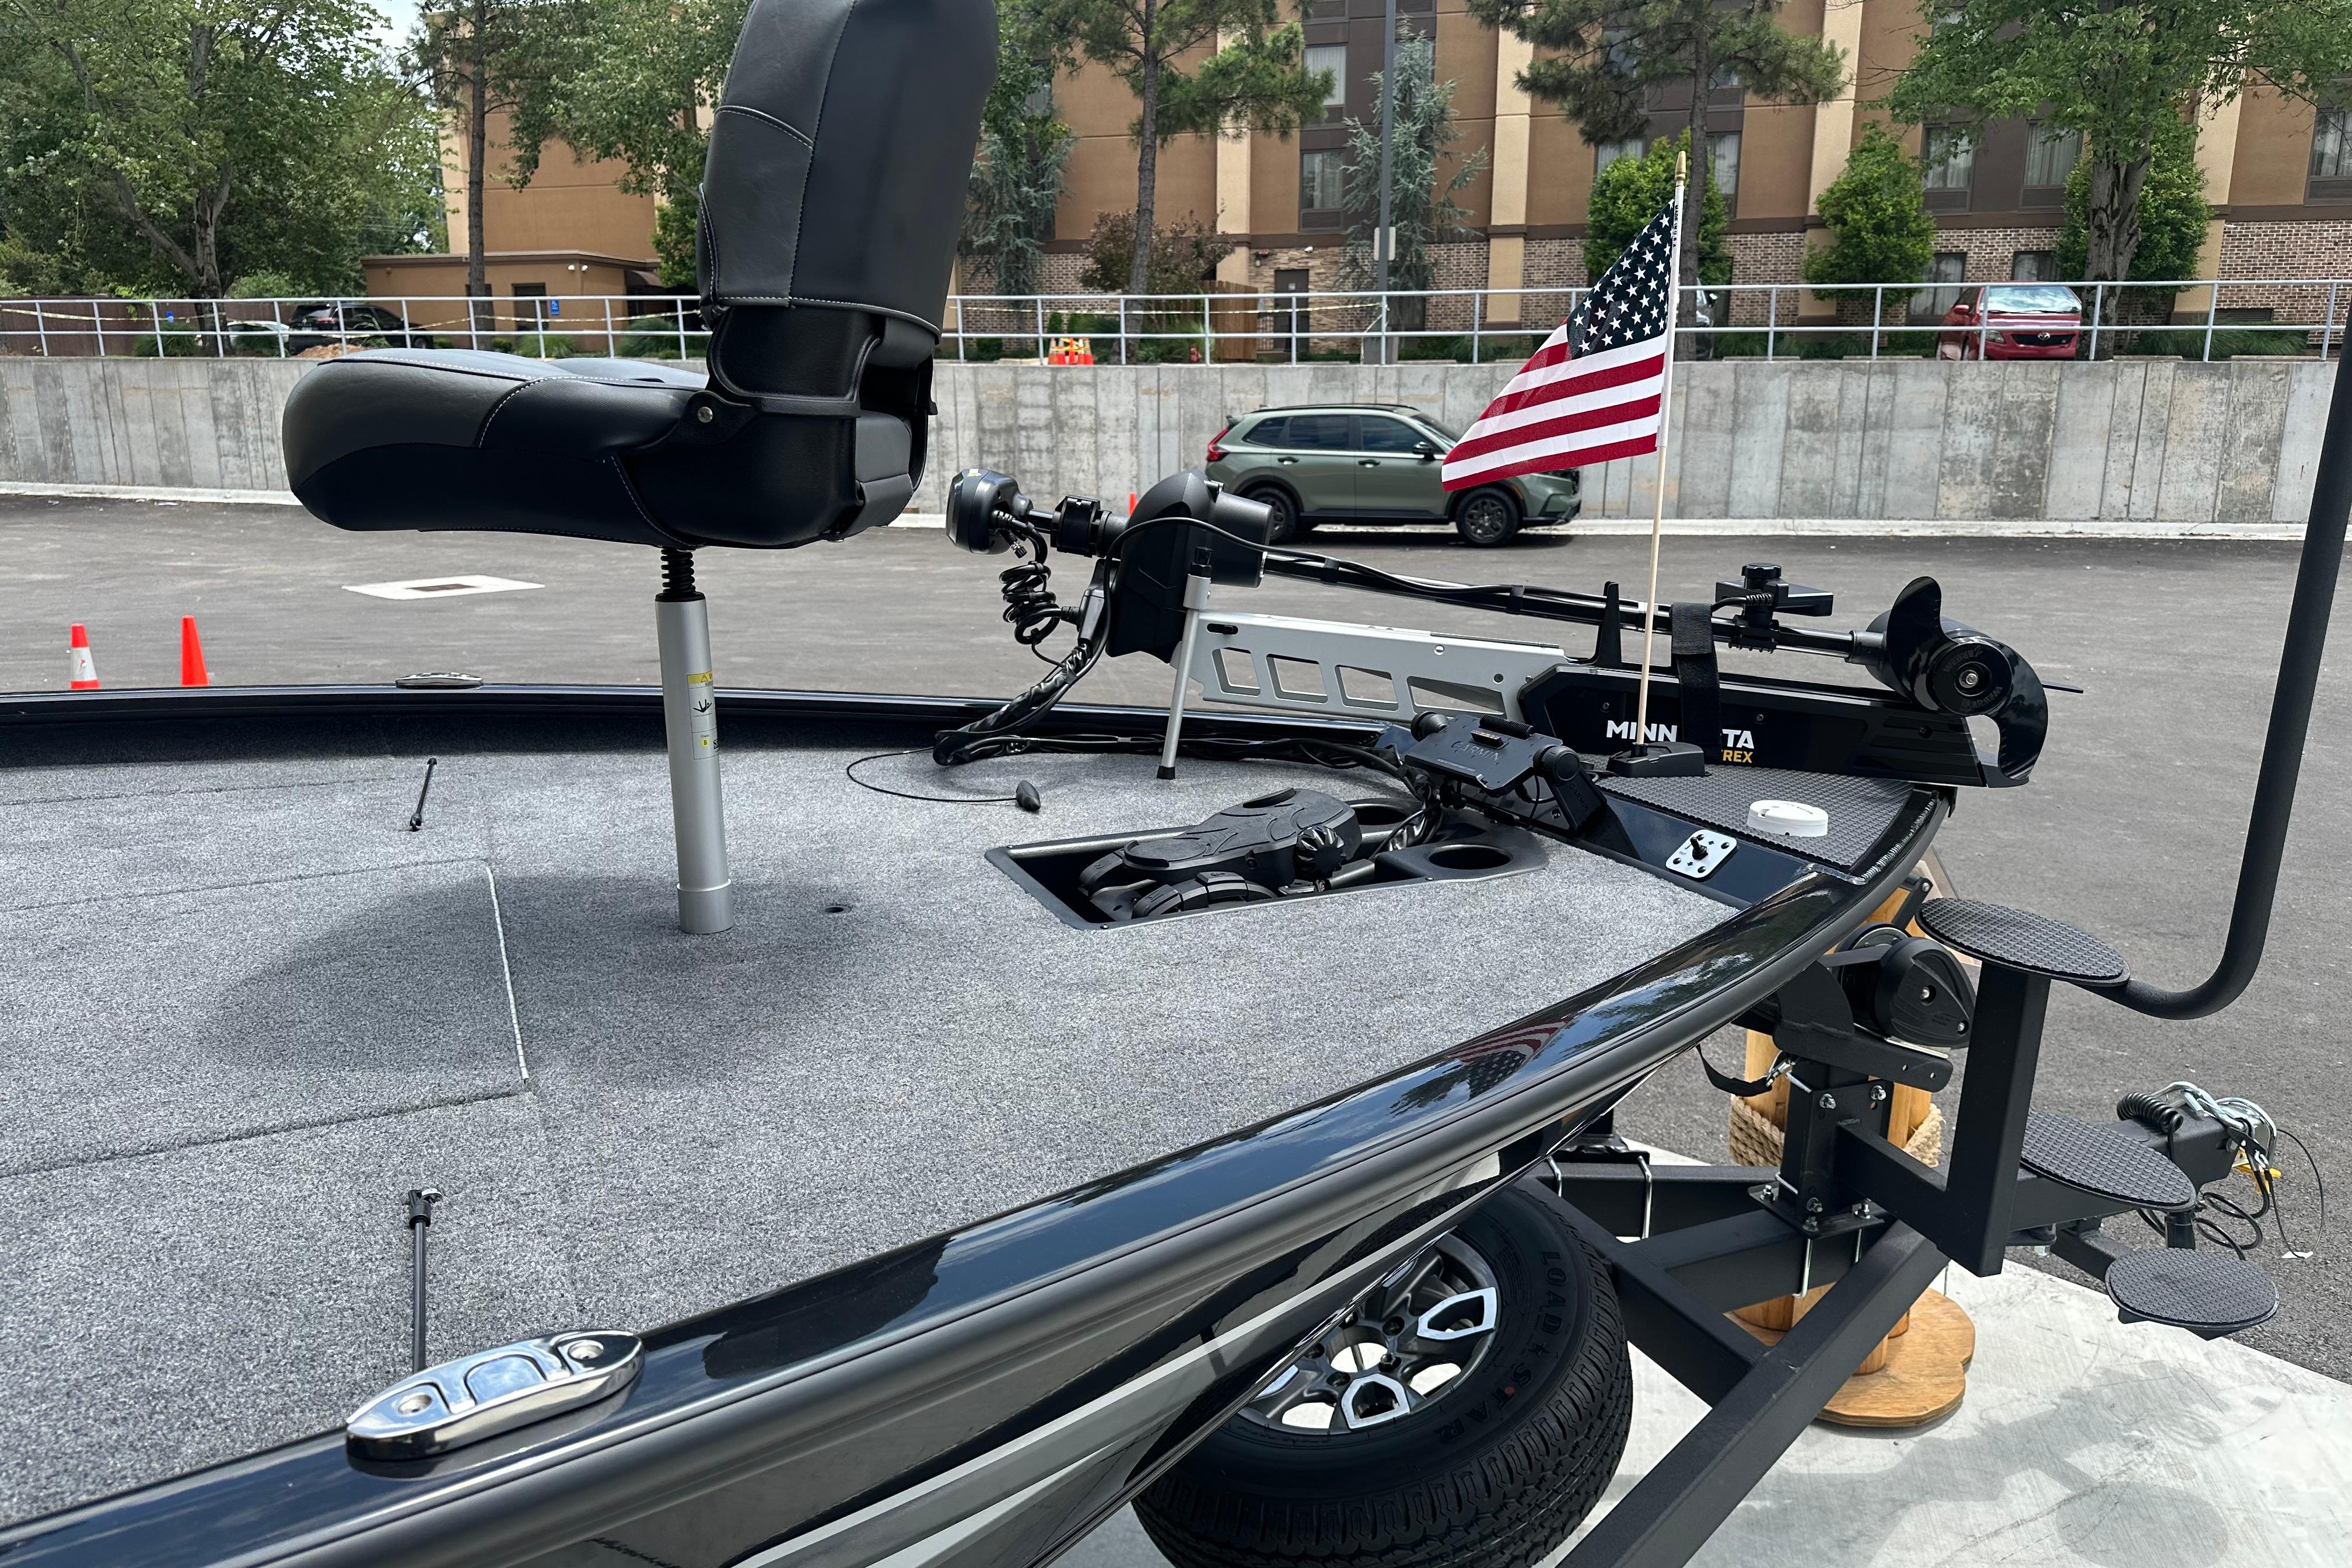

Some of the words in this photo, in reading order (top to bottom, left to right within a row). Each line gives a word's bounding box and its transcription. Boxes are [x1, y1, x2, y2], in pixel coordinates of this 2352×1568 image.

[1606, 720, 1678, 743] MINN
[1721, 729, 1755, 749] TA
[1451, 741, 1501, 761] GARMIN
[1721, 749, 1754, 764] REX
[1541, 1251, 1567, 1335] LOAD
[1434, 1362, 1534, 1443] STAR
